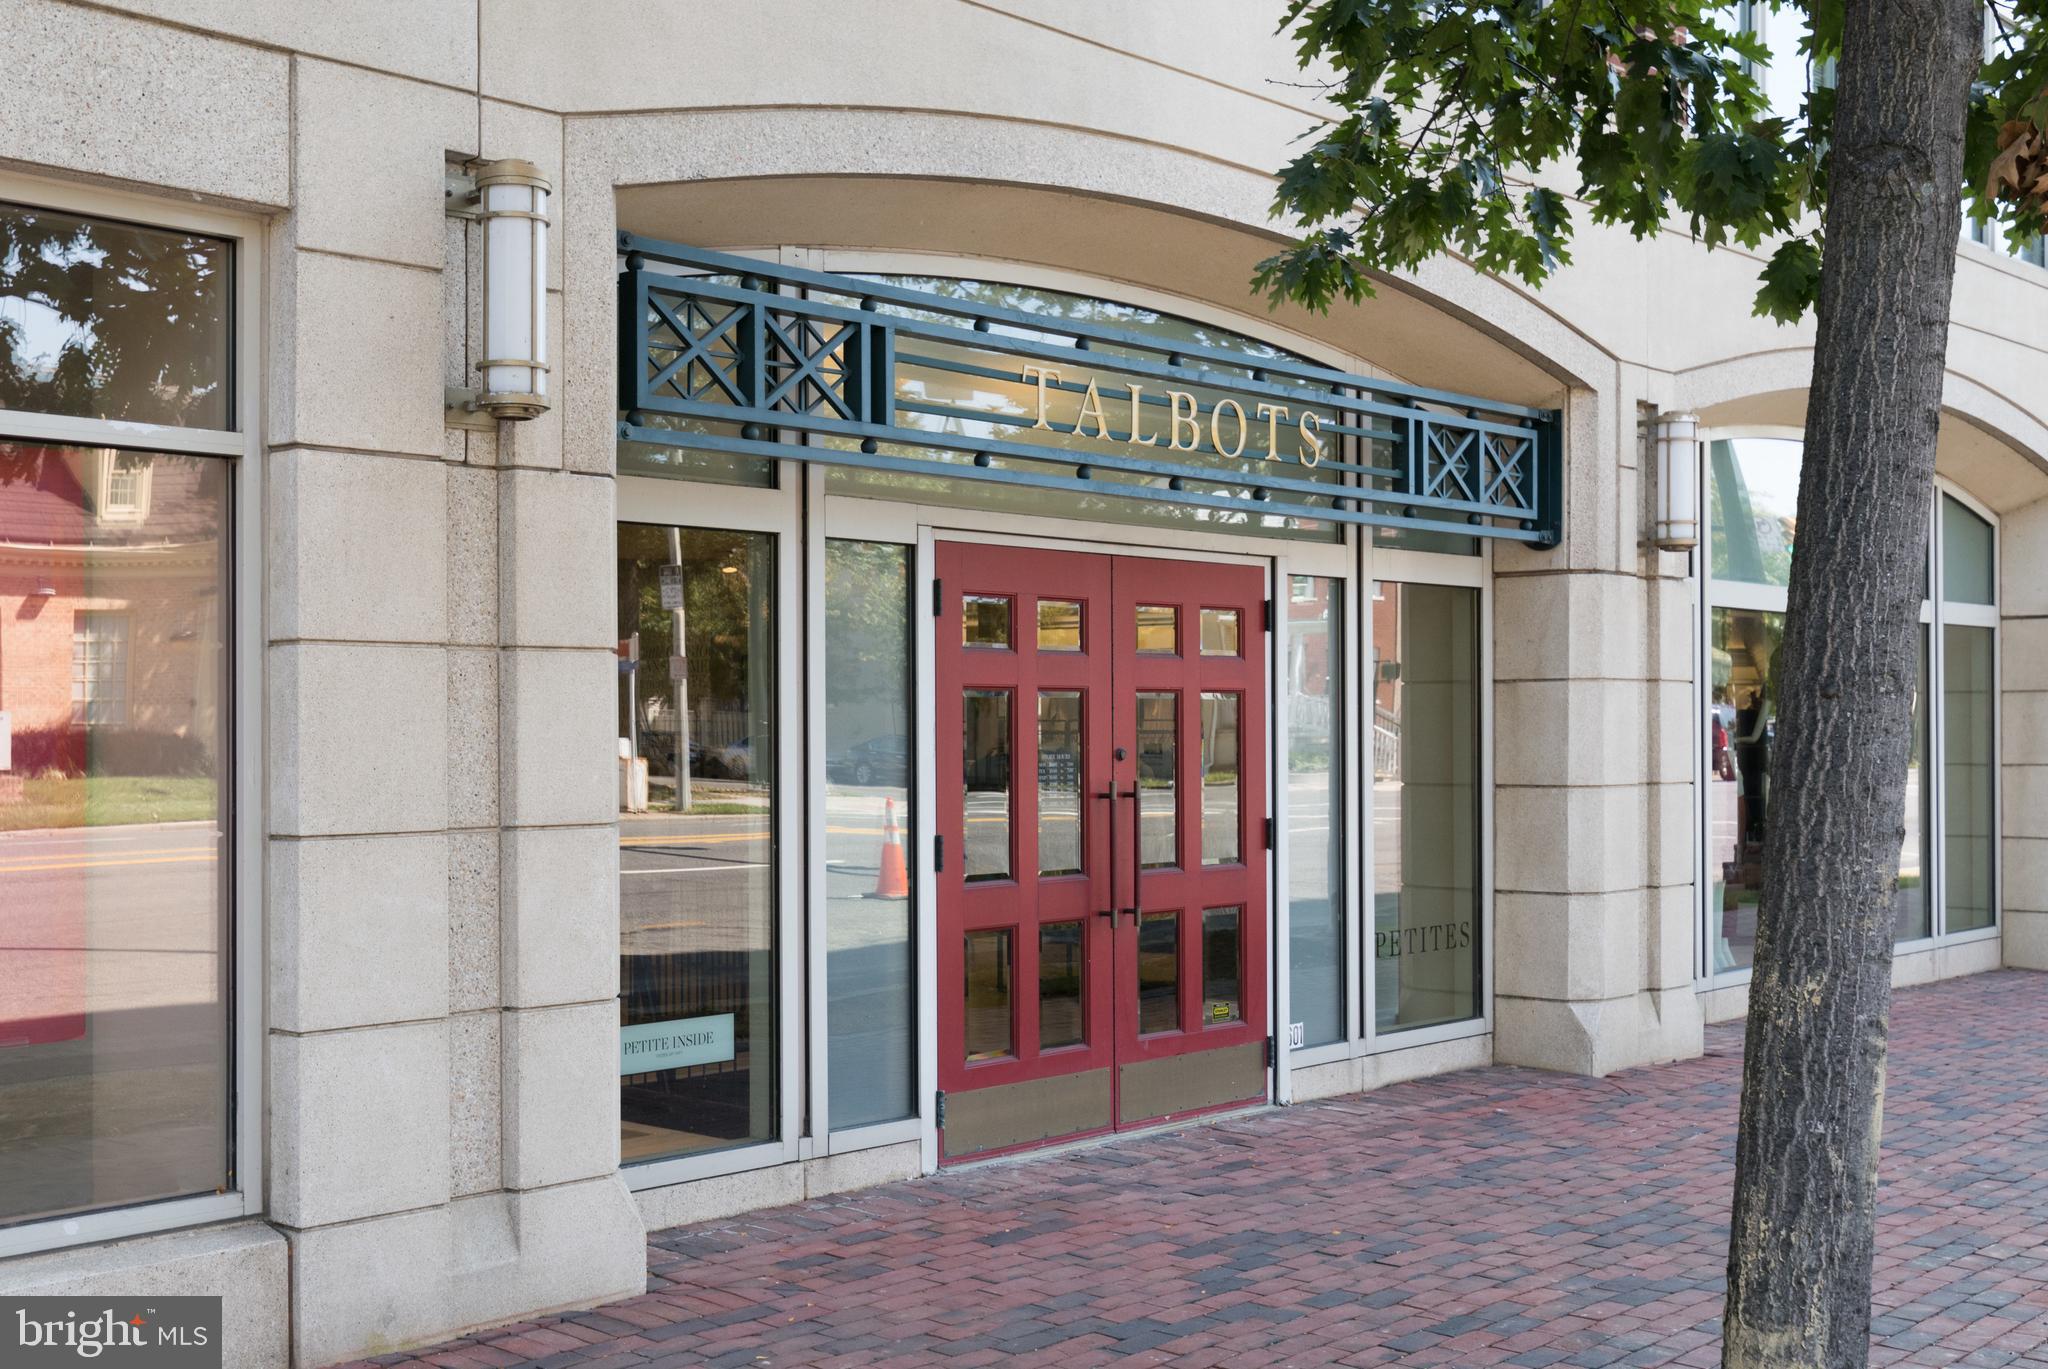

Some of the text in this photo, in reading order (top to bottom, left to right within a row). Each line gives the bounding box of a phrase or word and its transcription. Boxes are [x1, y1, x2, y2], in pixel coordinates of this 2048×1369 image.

[1022, 364, 1321, 468] TALBOTS
[1375, 921, 1470, 958] PETITES
[624, 1037, 669, 1055] PETITE
[672, 1031, 714, 1049] INSIDE
